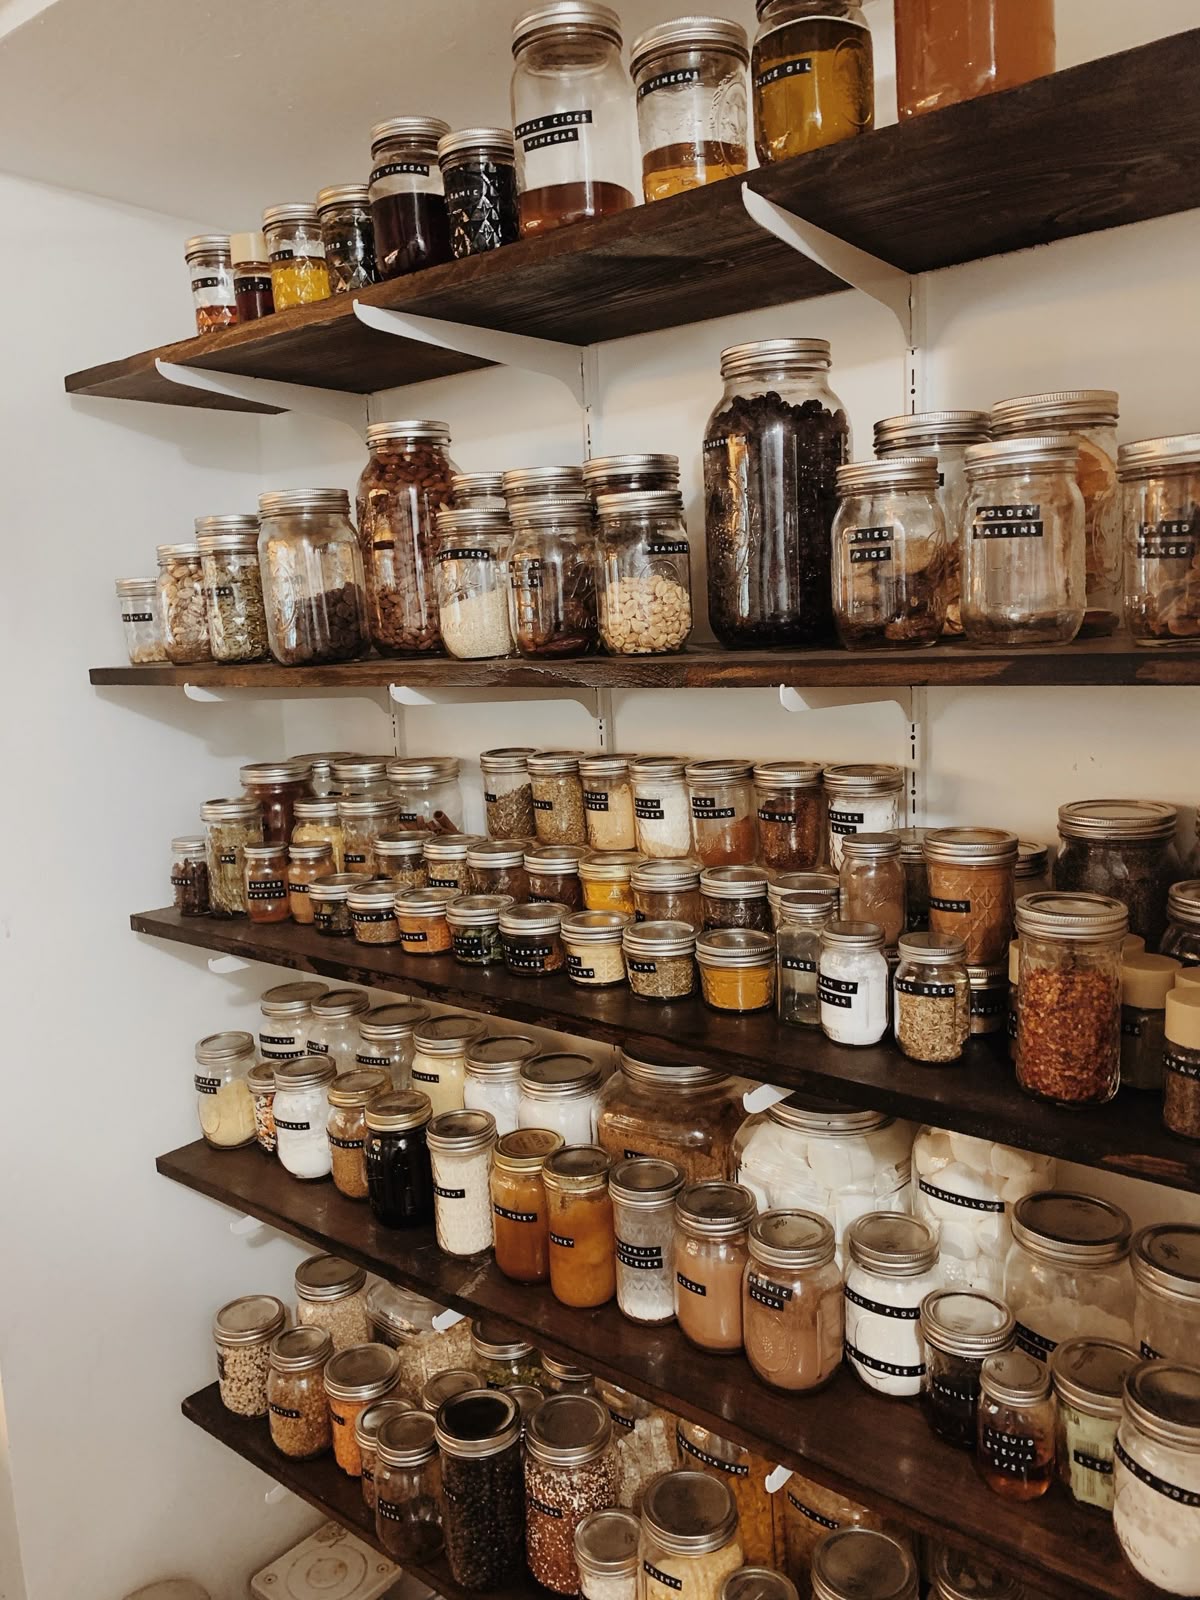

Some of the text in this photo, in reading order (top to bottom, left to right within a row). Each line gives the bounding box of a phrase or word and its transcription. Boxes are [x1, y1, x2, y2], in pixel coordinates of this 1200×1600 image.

[785, 61, 812, 74] OIL
[648, 70, 699, 89] VINEGAR
[516, 113, 589, 137] APPLE CIDER
[527, 131, 574, 148] VINEGAR
[383, 163, 430, 174] VINEGAR
[979, 508, 1035, 519] GOLDEN
[975, 526, 1038, 537] RAISINS
[1142, 524, 1190, 537] DRIED
[850, 531, 890, 546] DRIED
[1140, 546, 1188, 557] MANGO
[775, 814, 794, 822] RUB
[250, 881, 282, 890] SMOKED
[248, 891, 286, 899] PAPRIKA
[515, 948, 550, 957] PEPPER
[509, 957, 542, 968] FLAKES
[786, 959, 812, 970] SAGE
[923, 985, 956, 995] SEED
[339, 1140, 363, 1149] SUGAR
[920, 1183, 1001, 1210] MARSHMALLOWS
[507, 1213, 534, 1222] HONEY
[748, 1275, 788, 1299] ORGANIC
[751, 1289, 780, 1309] COCOA
[885, 1307, 920, 1318] FLOU
[934, 1382, 976, 1402] VANILL
[987, 1428, 1035, 1447] LIQUID
[986, 1440, 1033, 1460] STEVIA
[1078, 1455, 1112, 1472] STEV
